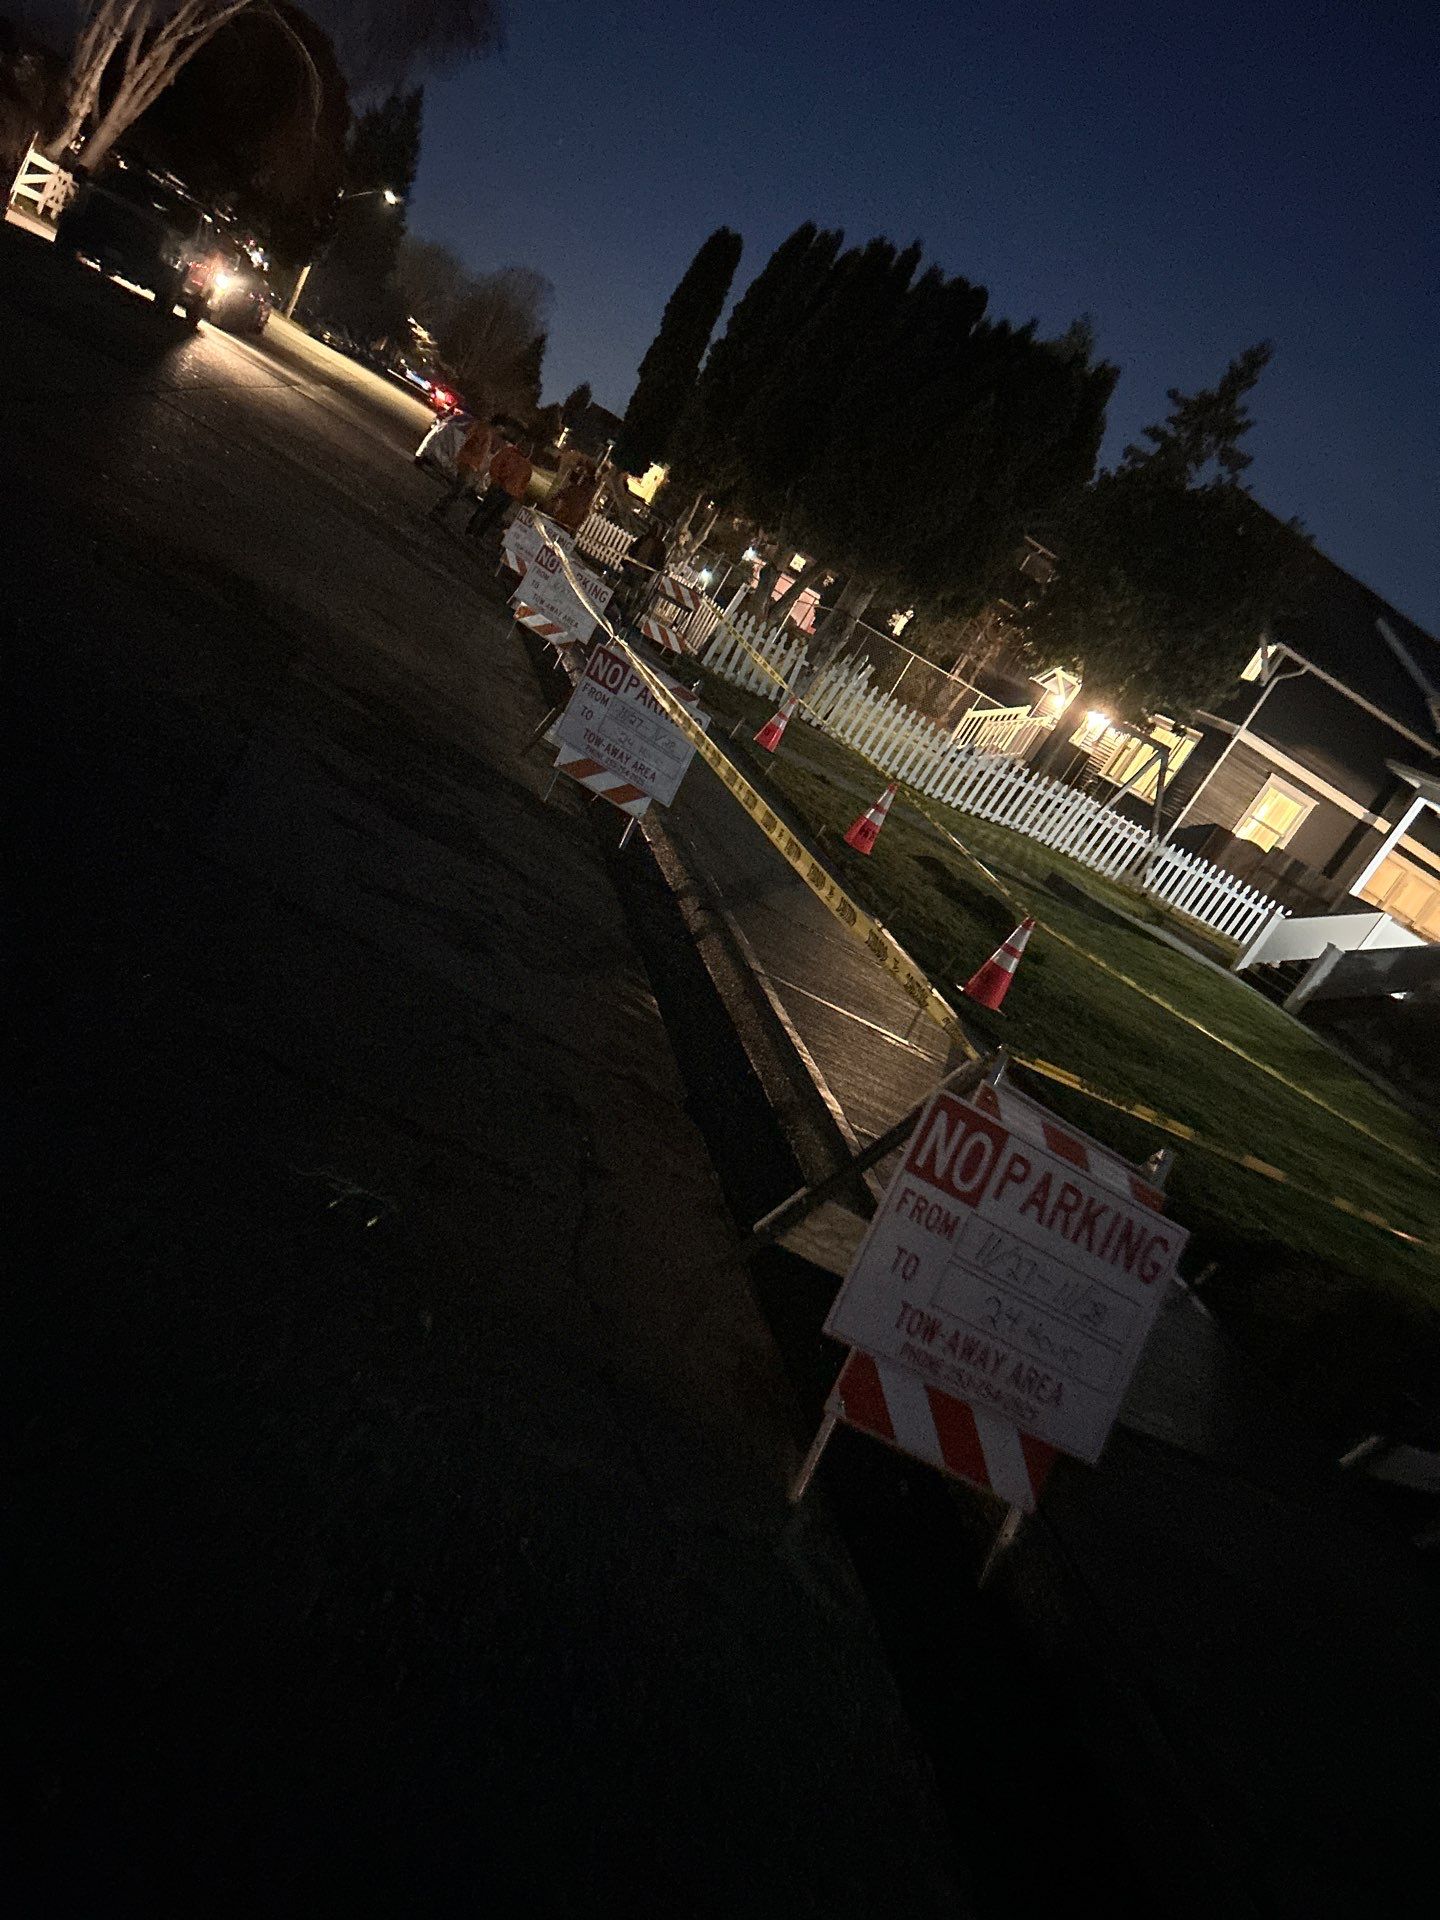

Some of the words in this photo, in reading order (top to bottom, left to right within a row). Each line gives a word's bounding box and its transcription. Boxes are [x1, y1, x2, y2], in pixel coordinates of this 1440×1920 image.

[534, 547, 561, 572] NO
[588, 651, 626, 691] NO
[579, 705, 594, 721] TO
[581, 681, 610, 707] FROM
[581, 727, 631, 766] TOW-AWAY
[630, 758, 657, 782] AREA
[894, 1186, 962, 1241] FROM
[912, 1108, 999, 1198] NO
[990, 1150, 1173, 1288] PARKING
[886, 1245, 923, 1284] TO
[890, 1299, 1009, 1379] TOW-AWAY
[1007, 1359, 1068, 1409] AREA
